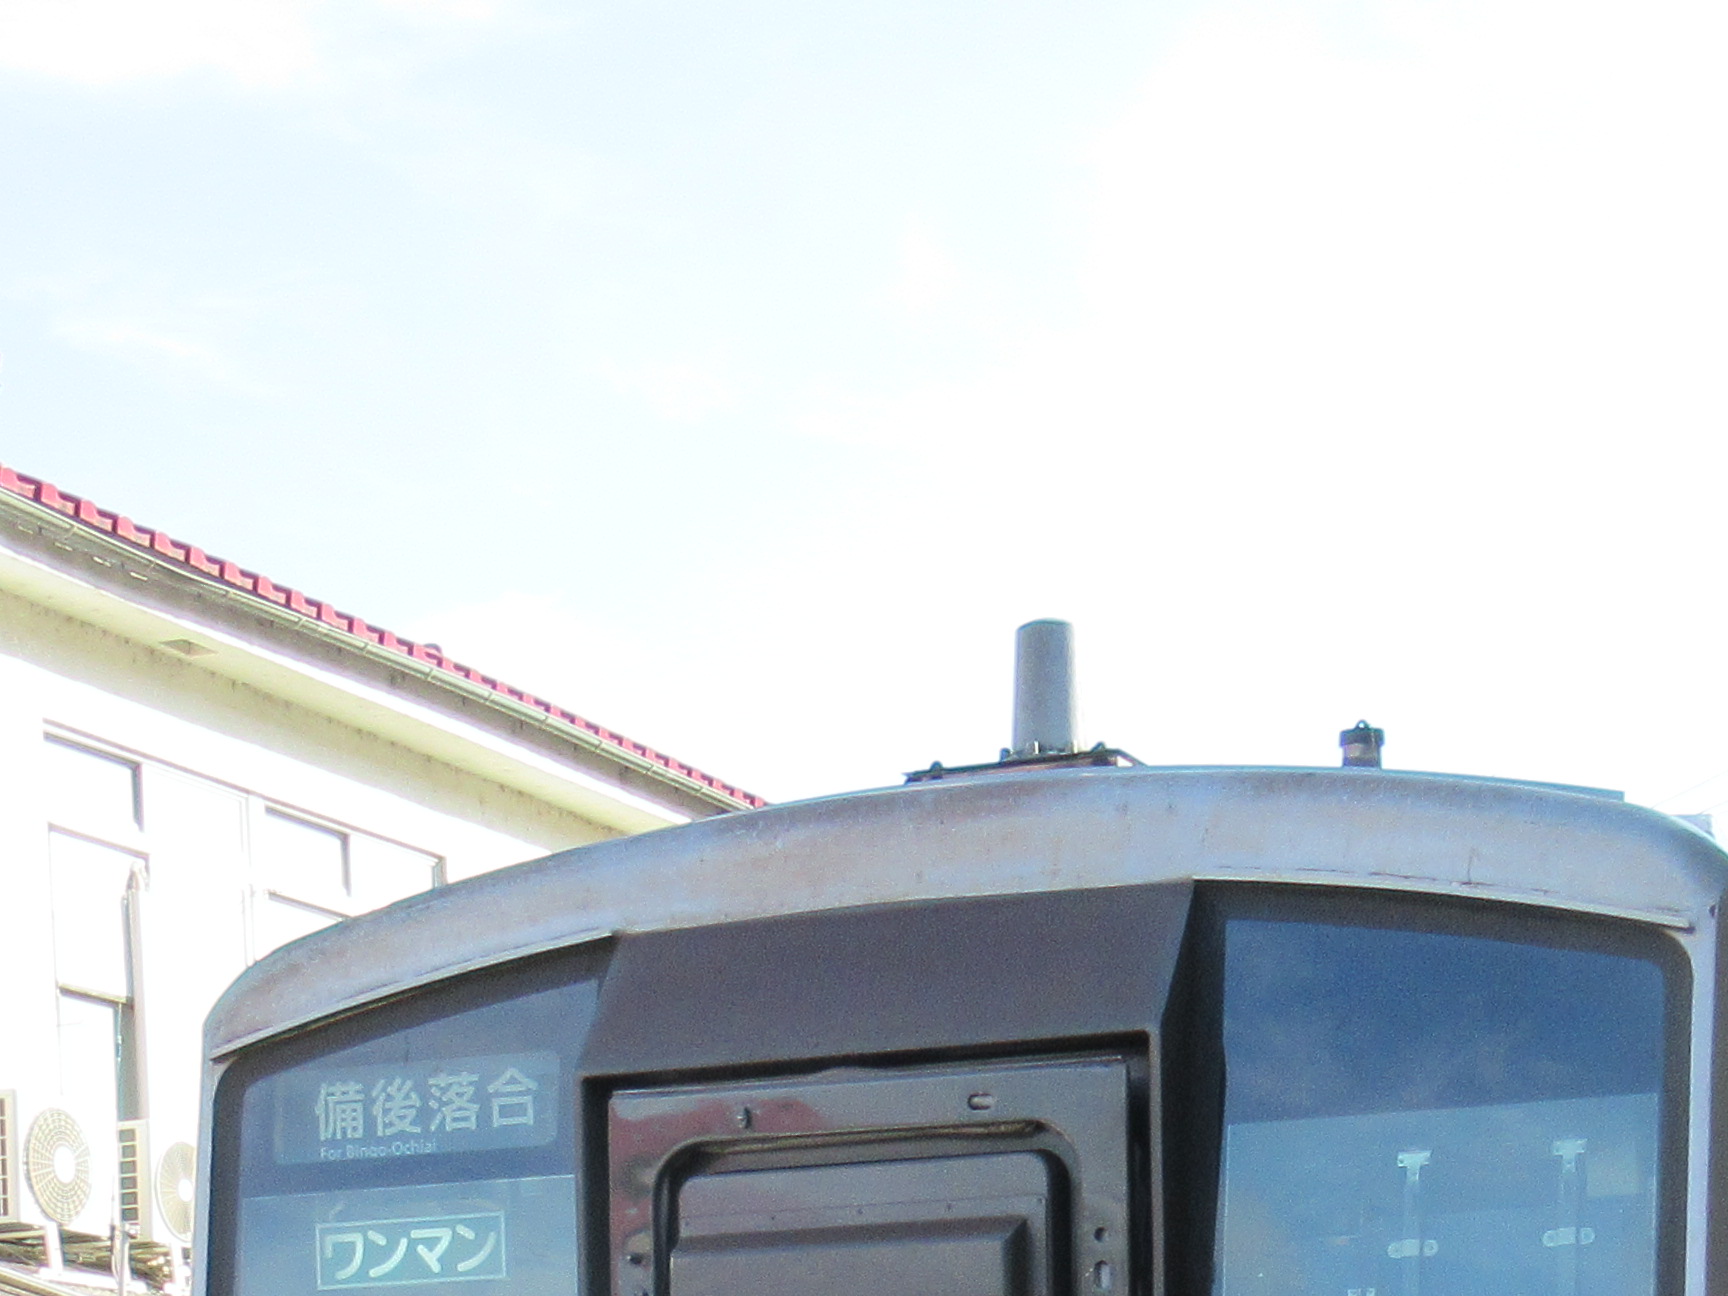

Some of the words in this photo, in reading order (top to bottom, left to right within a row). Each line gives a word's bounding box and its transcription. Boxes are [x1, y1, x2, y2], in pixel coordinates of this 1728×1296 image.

[315, 1068, 539, 1140] 備後落合
[320, 1146, 344, 1160] For
[325, 1224, 497, 1280] ワンマン
